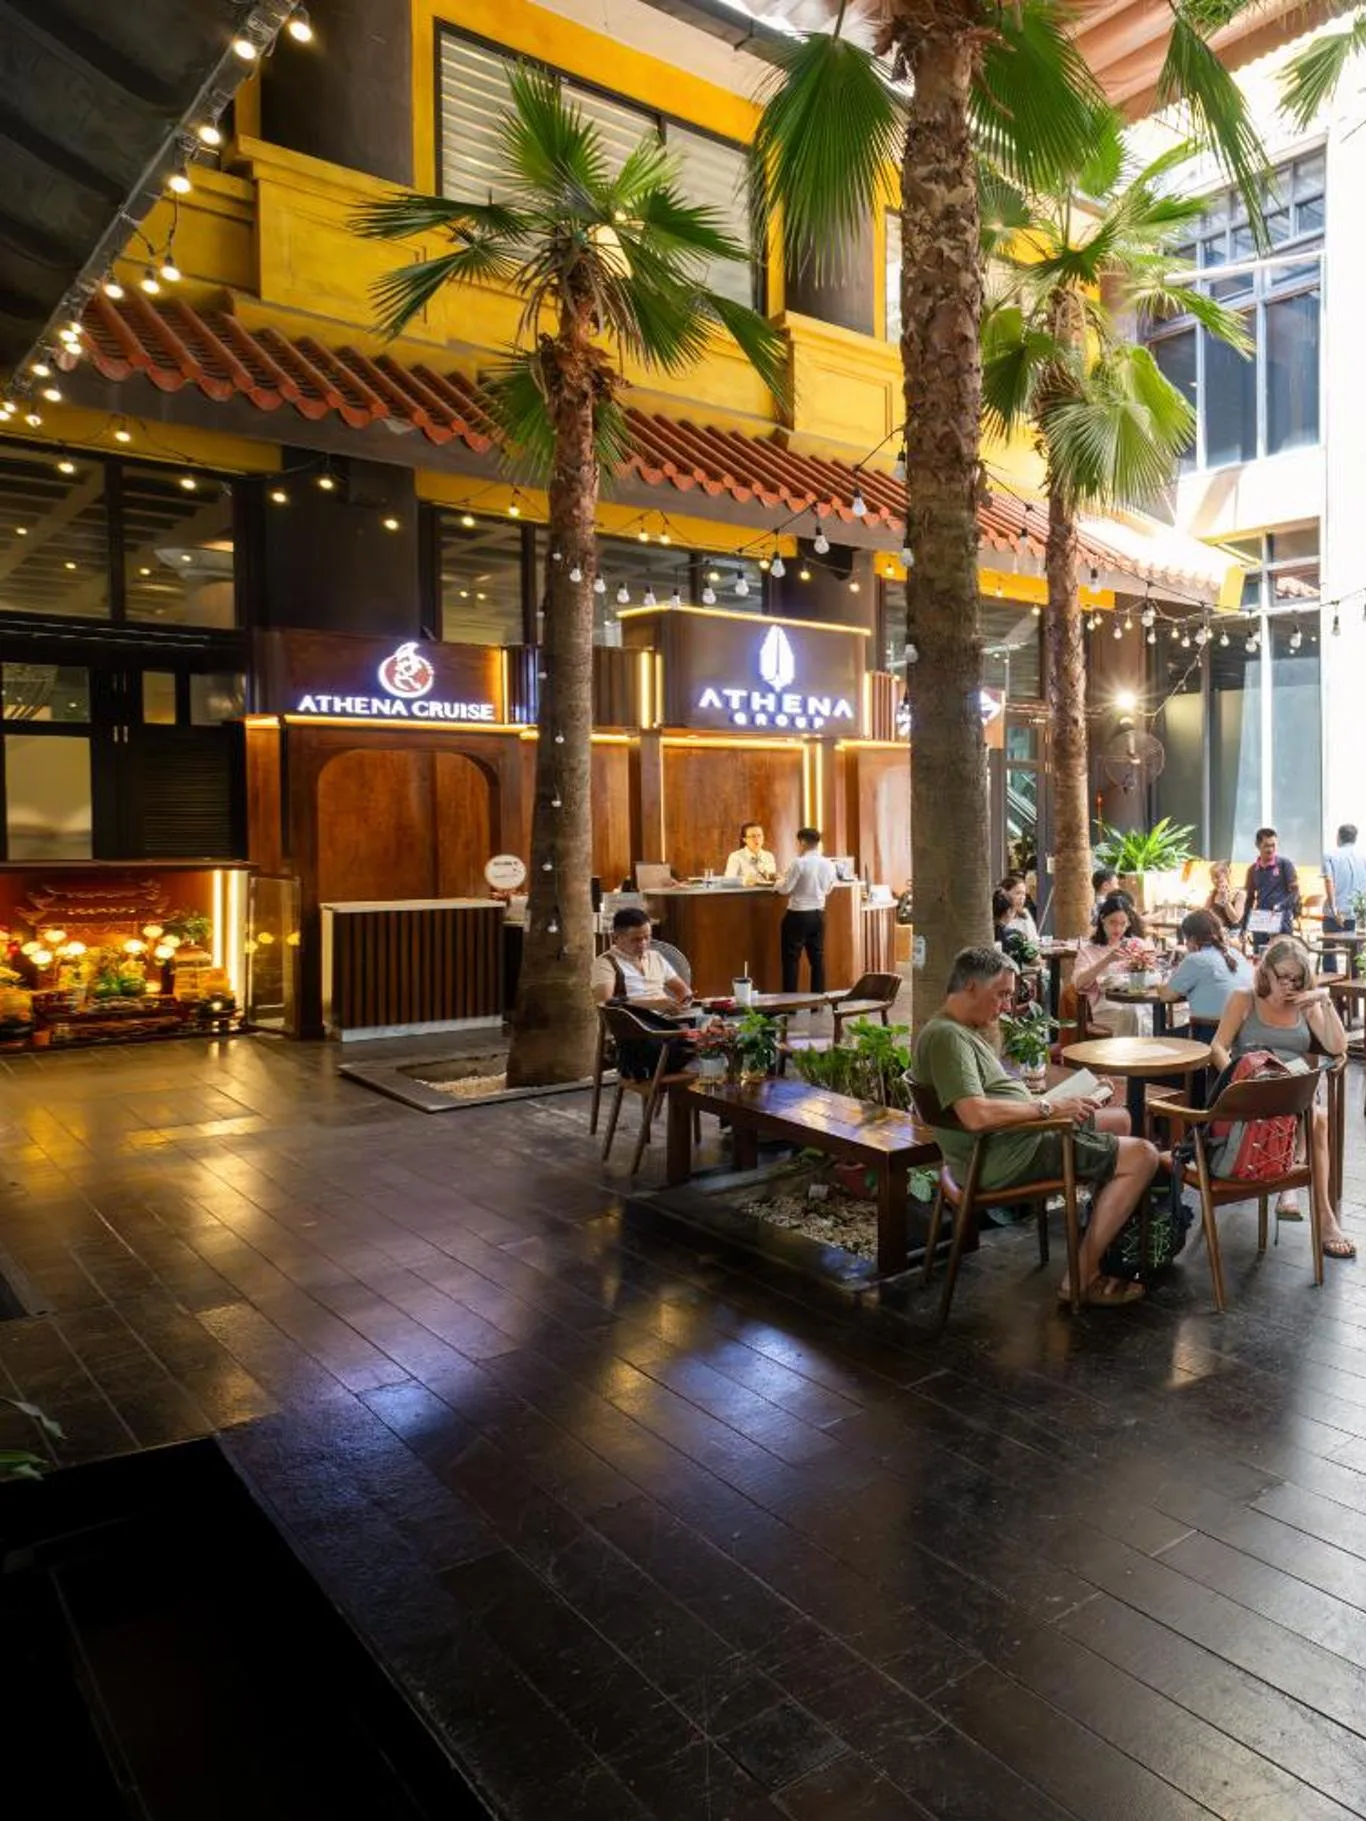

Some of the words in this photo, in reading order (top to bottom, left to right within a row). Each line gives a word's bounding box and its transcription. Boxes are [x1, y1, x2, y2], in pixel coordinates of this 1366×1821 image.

[298, 695, 408, 716] ATHENA
[411, 700, 495, 720] CRUISE
[699, 688, 853, 718] ATHENA
[733, 712, 824, 729] GROUP
